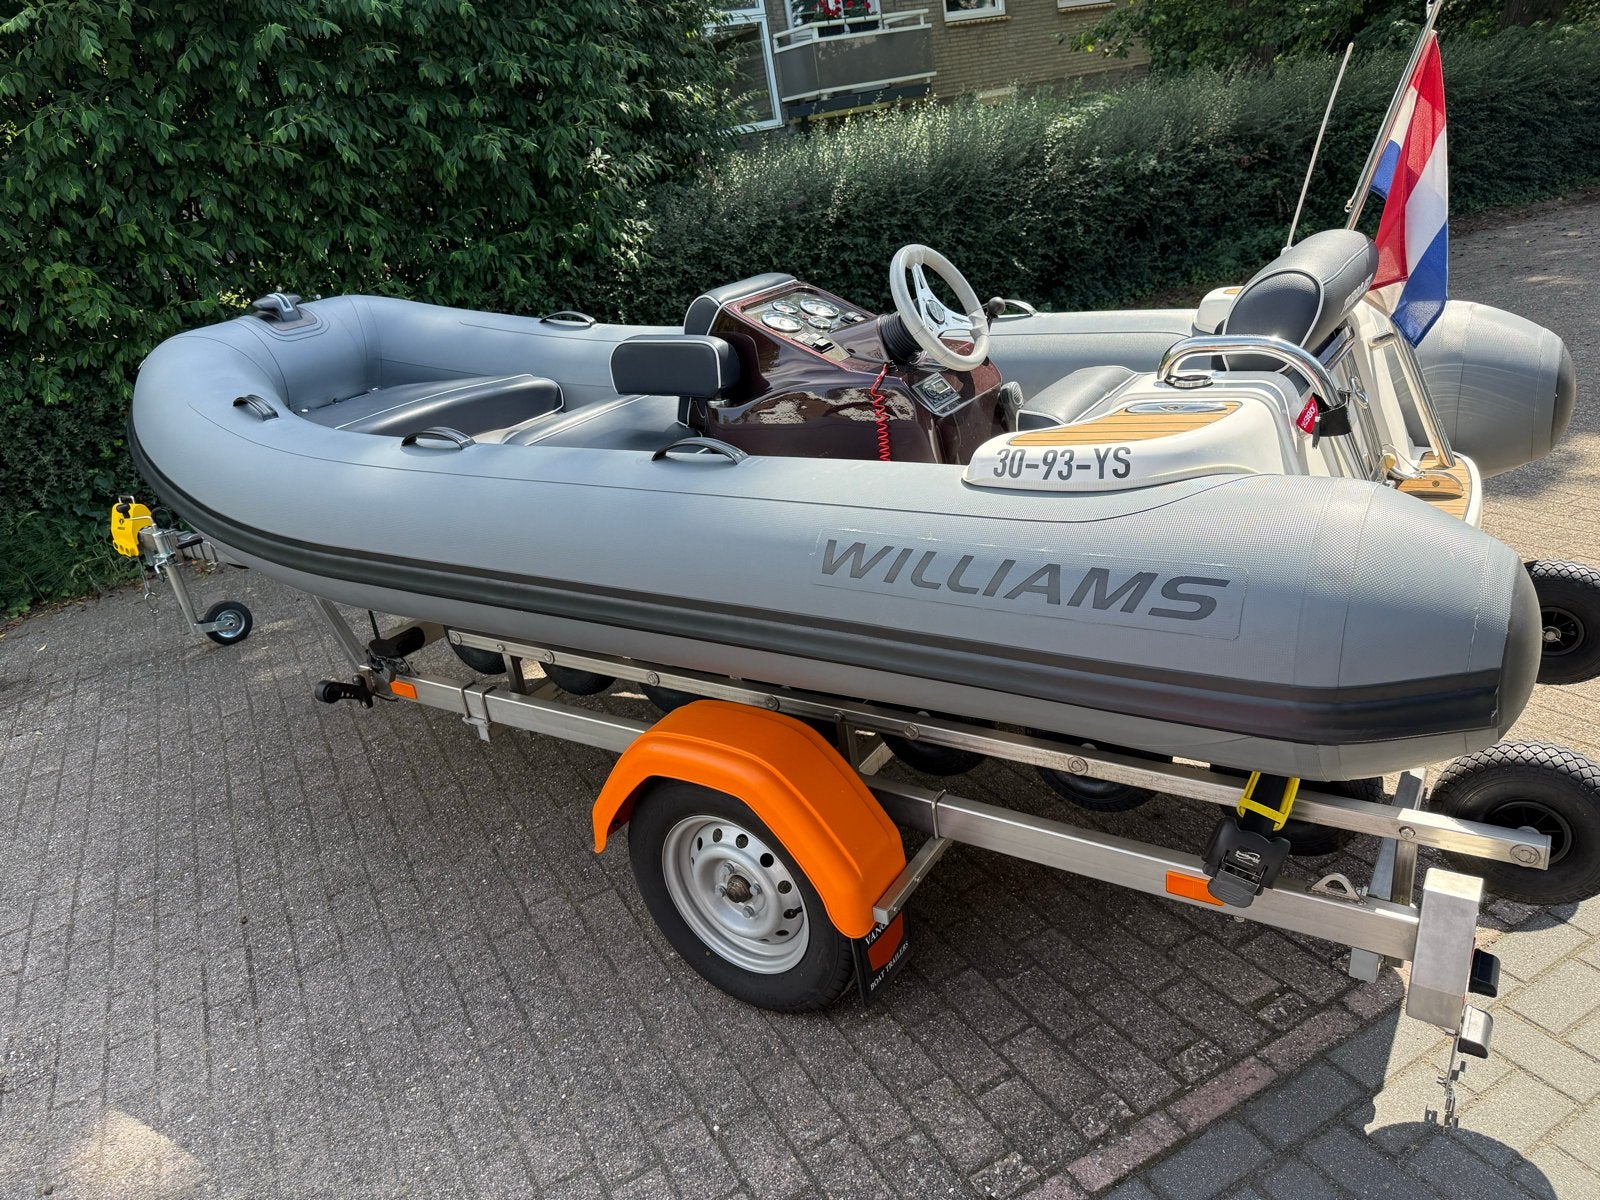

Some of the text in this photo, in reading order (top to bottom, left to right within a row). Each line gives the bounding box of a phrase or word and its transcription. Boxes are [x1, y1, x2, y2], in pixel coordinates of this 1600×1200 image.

[993, 446, 1132, 481] 30-93-YS
[821, 539, 1231, 621] WILLIAMS
[870, 941, 908, 991] BOAT TRAILERS
